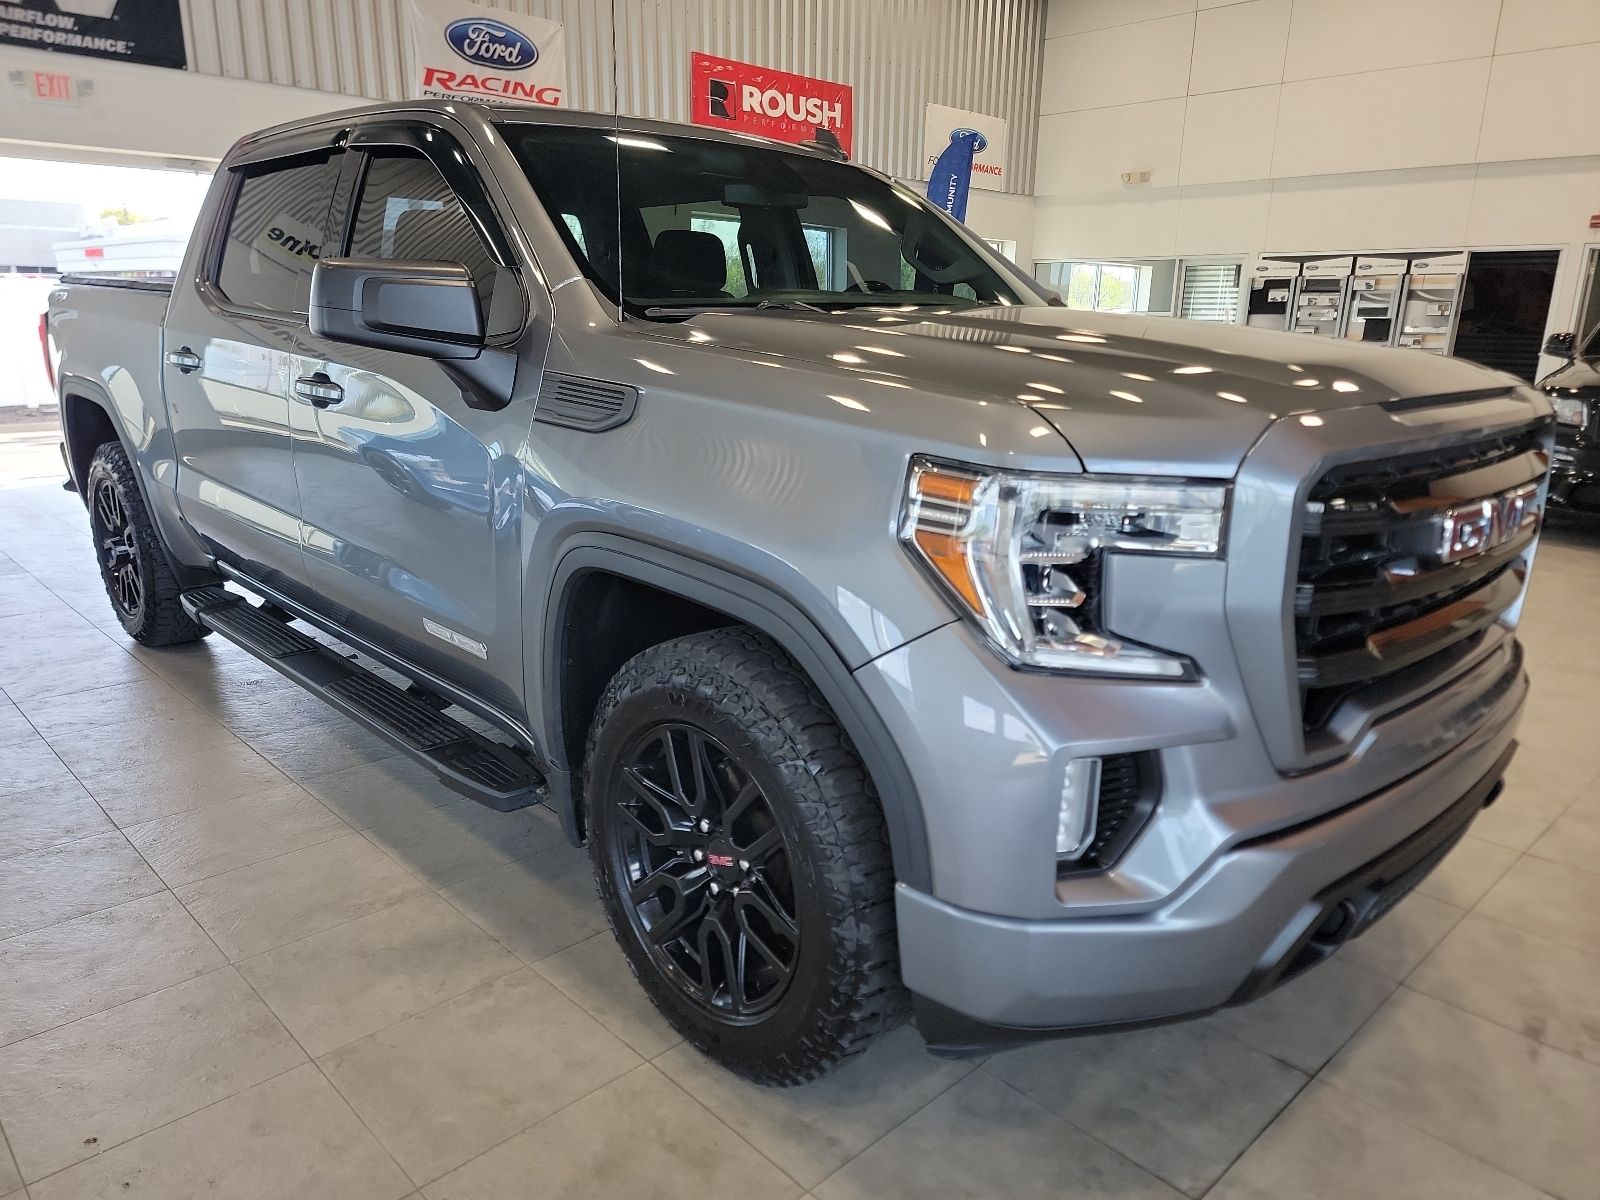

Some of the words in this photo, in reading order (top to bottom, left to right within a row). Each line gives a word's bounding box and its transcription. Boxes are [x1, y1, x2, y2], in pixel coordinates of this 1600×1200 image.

[464, 25, 522, 64] Ford
[34, 72, 71, 100] EXIT
[423, 67, 561, 106] RACING
[742, 84, 842, 129] ROUSH
[971, 163, 1002, 176] RMANCE
[945, 173, 958, 216] MUNITY
